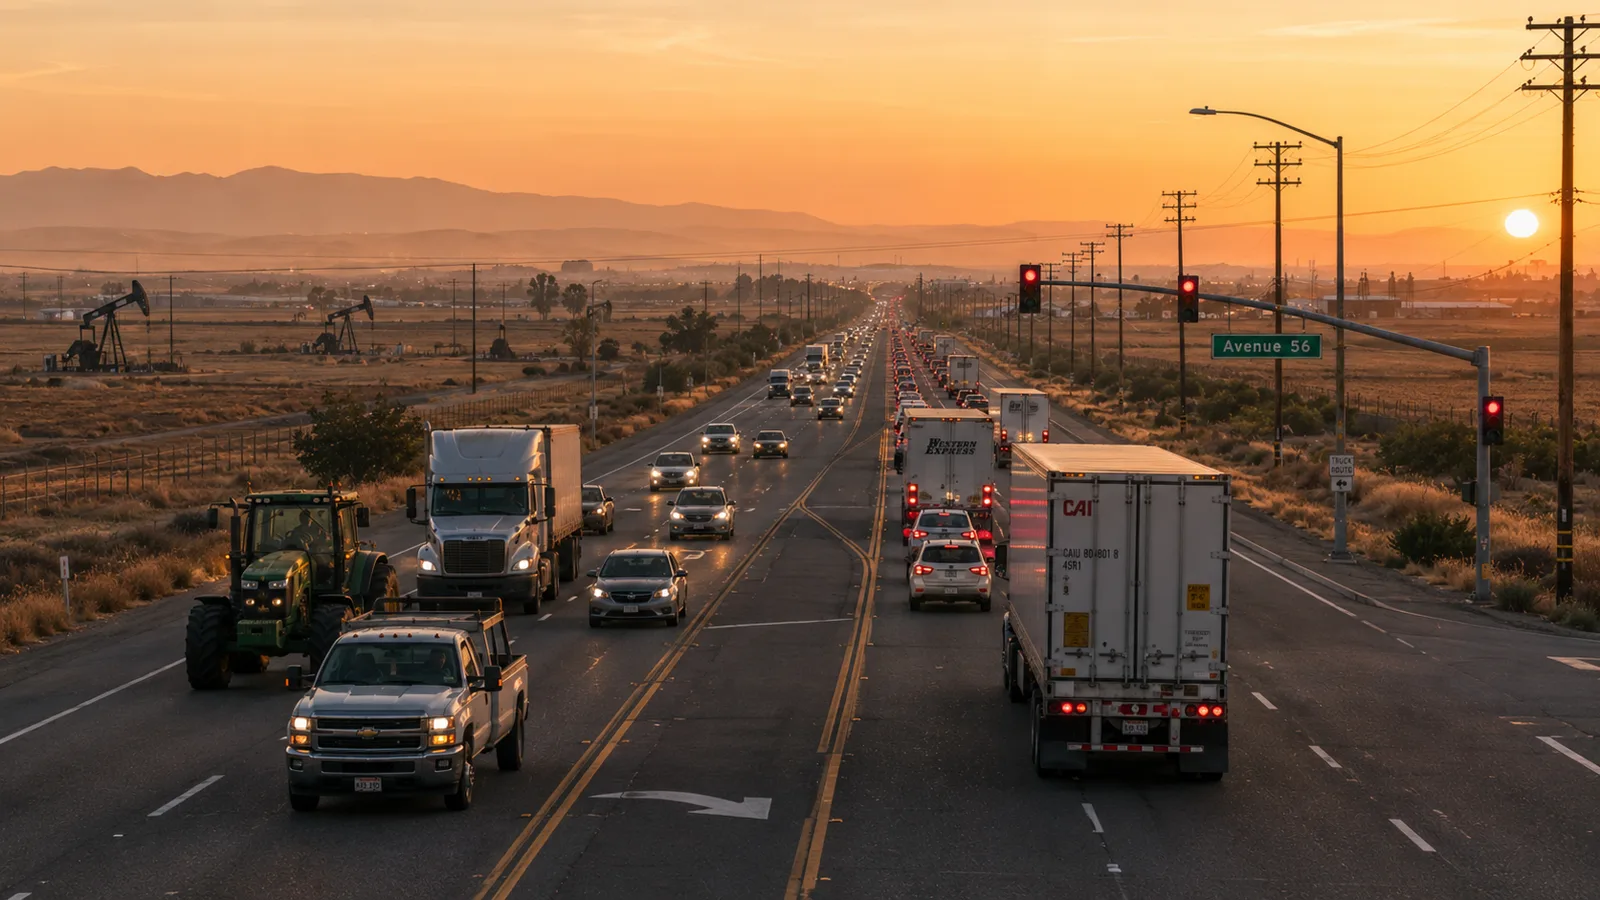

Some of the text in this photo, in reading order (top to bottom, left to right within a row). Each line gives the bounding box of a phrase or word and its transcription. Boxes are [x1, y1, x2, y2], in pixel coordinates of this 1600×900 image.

[1223, 340, 1310, 353] Avenue 56
[929, 437, 977, 448] WESTERN
[924, 445, 976, 455] EXPRESS
[1063, 500, 1092, 517] CAI
[1063, 548, 1080, 559] CAIU
